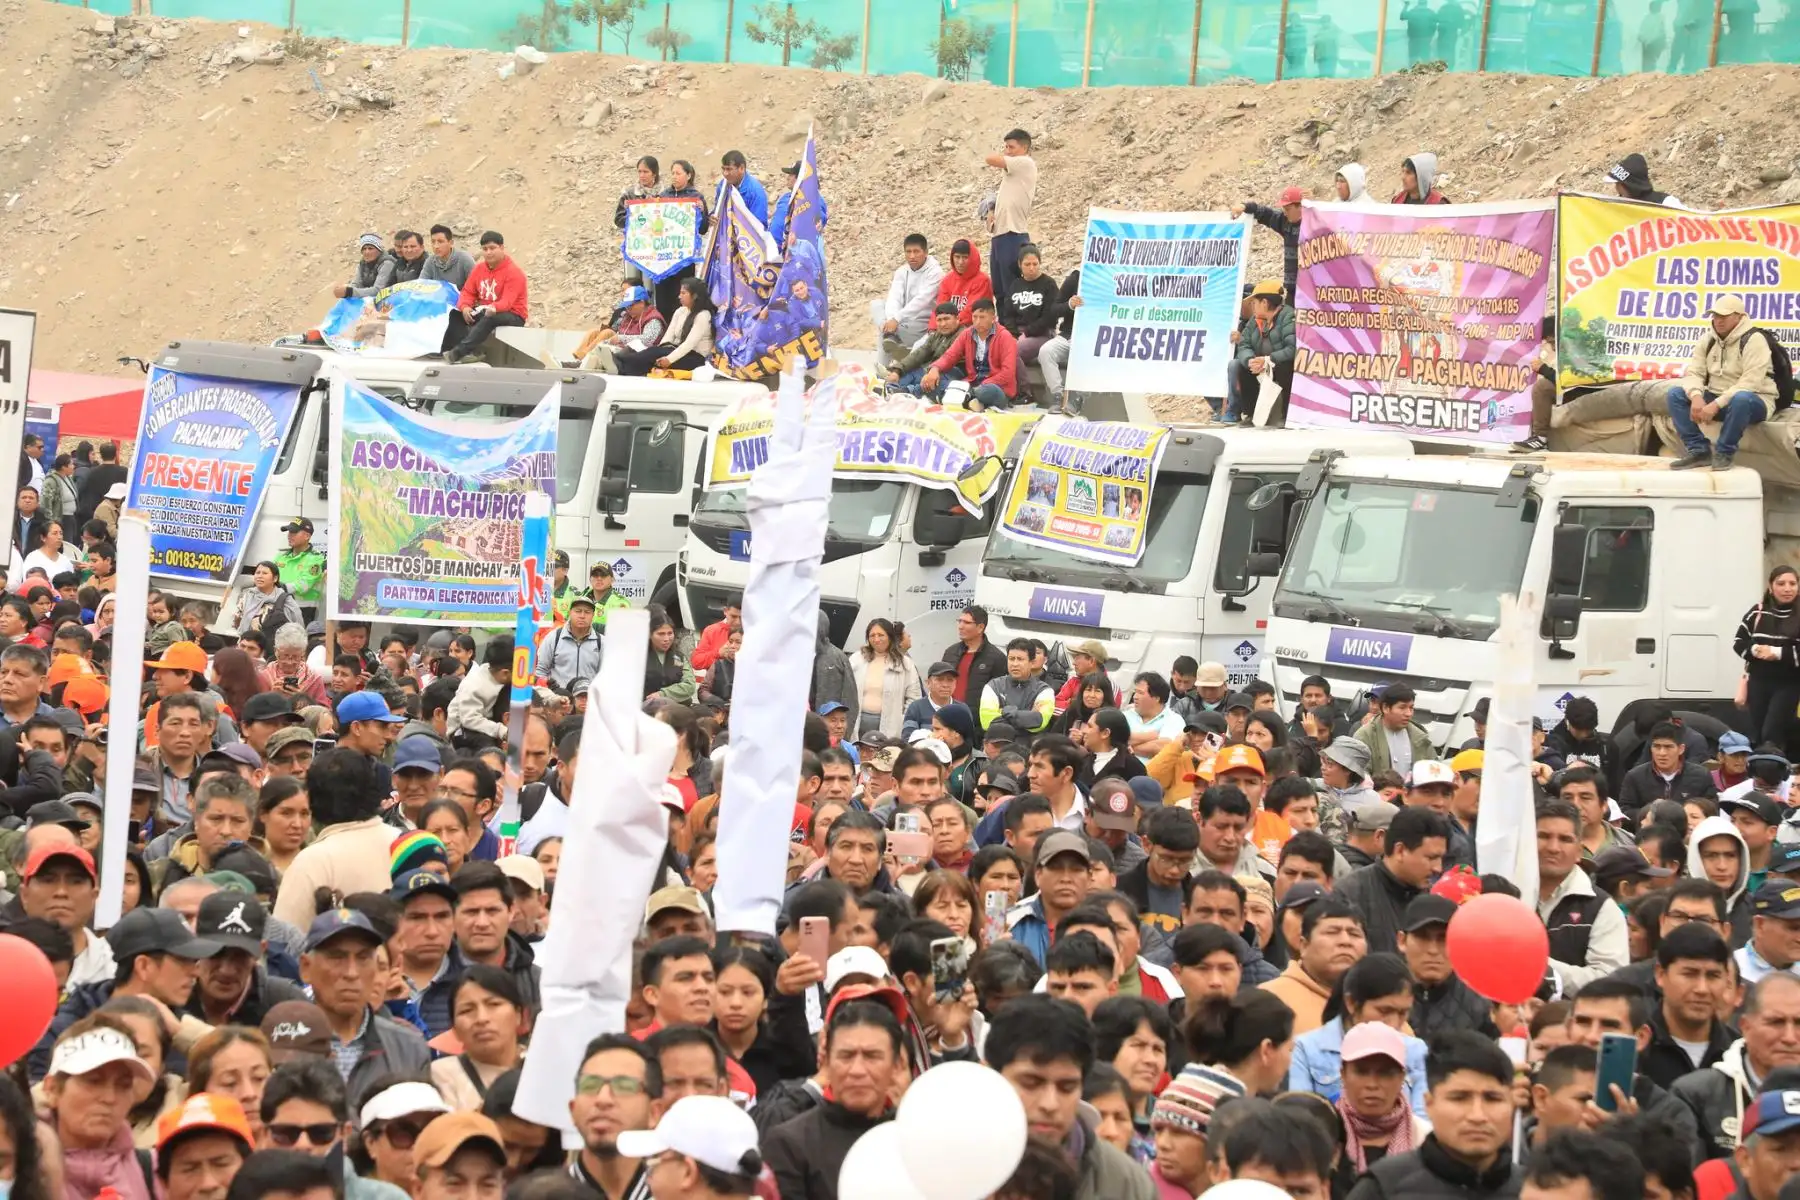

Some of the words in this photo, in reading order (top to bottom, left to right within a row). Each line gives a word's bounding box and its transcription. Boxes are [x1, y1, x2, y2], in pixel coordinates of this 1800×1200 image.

[1718, 217, 1758, 244] DE
[1119, 239, 1134, 266] DE
[1656, 257, 1700, 286] LAS
[1704, 258, 1780, 287] LOMAS
[1111, 305, 1128, 319] Por
[1133, 306, 1145, 321] el
[1148, 307, 1203, 322] desarrollo
[1616, 290, 1650, 318] DE
[1652, 291, 1698, 319] LOS
[1295, 308, 1364, 329] ESOLUCIÓN
[1606, 323, 1653, 339] PARTIDA
[1094, 325, 1207, 361] PRESENTE
[1607, 340, 1630, 355] RSG
[1412, 358, 1531, 393] PACHACAMAC
[145, 388, 220, 440] COMERCIANTES
[1350, 392, 1481, 432] PRESENTE
[172, 421, 248, 450] PACHACAMAC
[1040, 441, 1076, 468] CRUZ
[1073, 448, 1094, 473] DE
[140, 452, 256, 496] PRESENTE
[169, 498, 202, 511] ESFUERZO
[181, 527, 211, 540] NUESTRA
[213, 530, 234, 543] META
[219, 517, 239, 529] PARA
[166, 549, 223, 572] 00183-2023
[356, 553, 421, 576] HUERTOS
[424, 557, 441, 576] DE
[443, 558, 502, 578] MANCHAY
[384, 585, 436, 602] PARTIDA
[438, 588, 507, 605] ELECTRONICA
[1043, 597, 1087, 617] MINSA
[1342, 637, 1392, 660] MINSA
